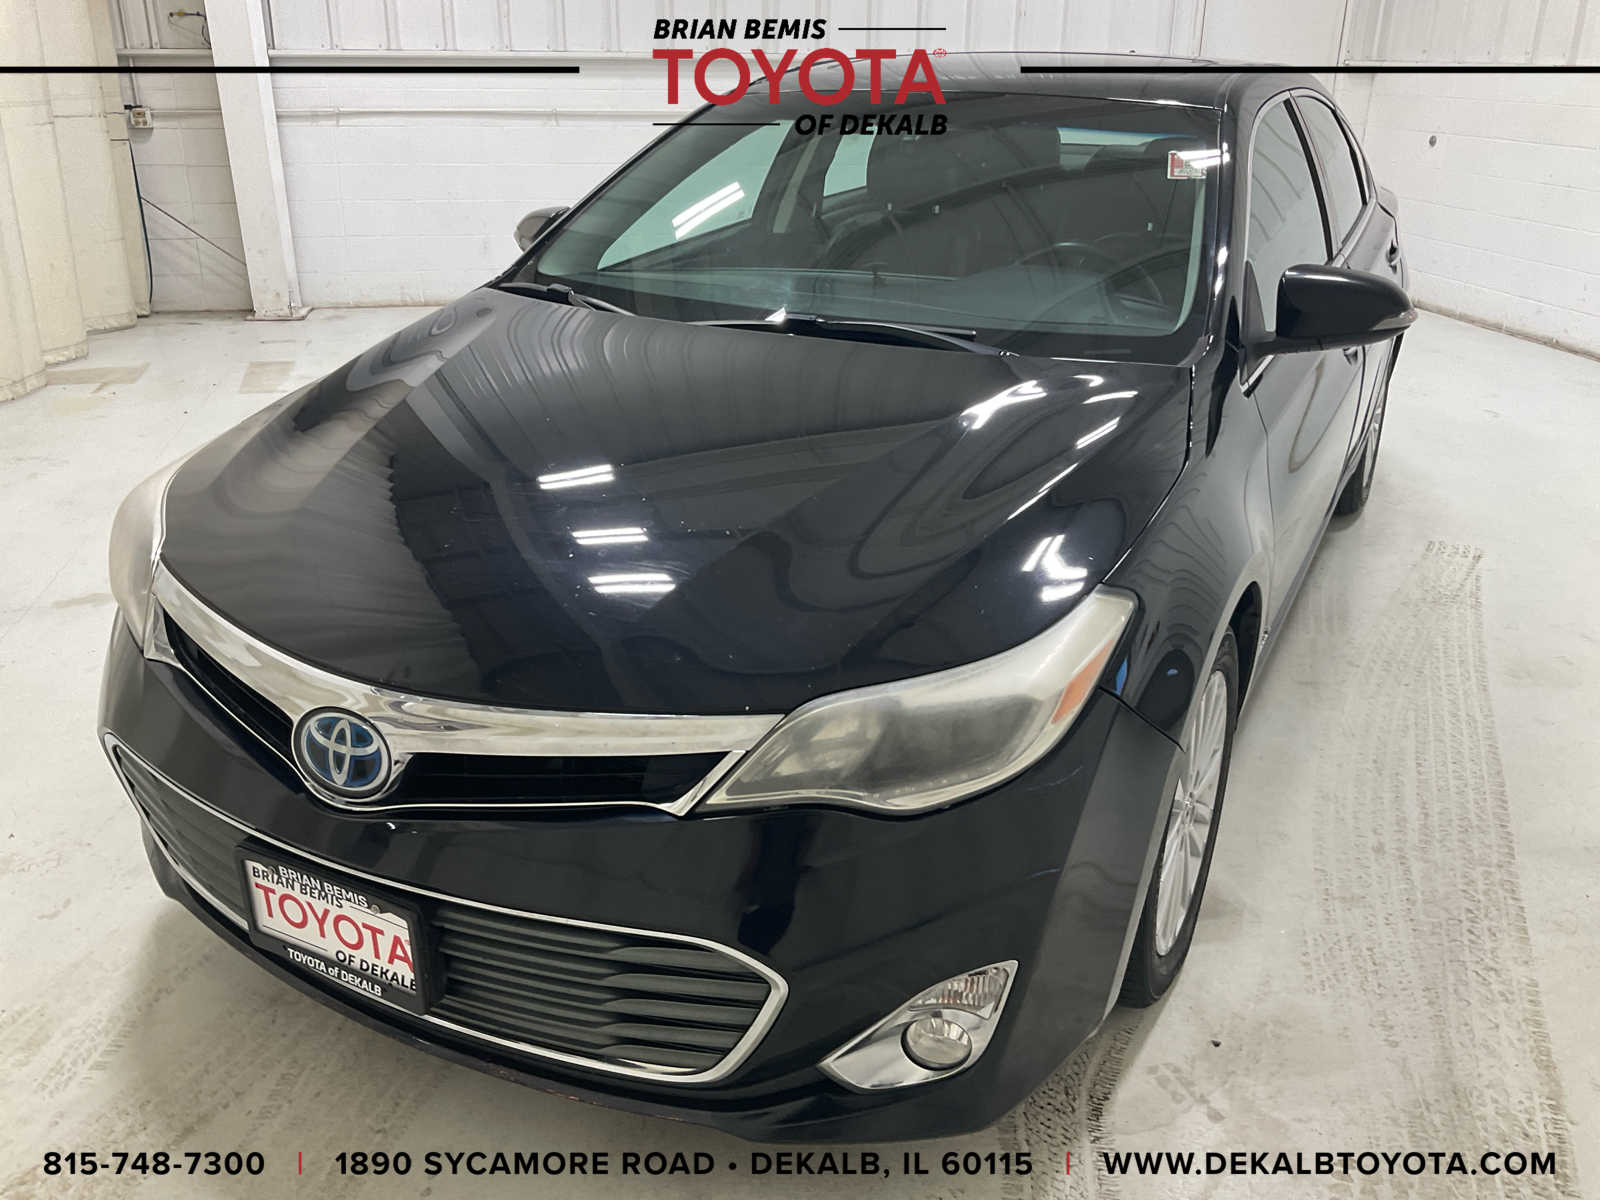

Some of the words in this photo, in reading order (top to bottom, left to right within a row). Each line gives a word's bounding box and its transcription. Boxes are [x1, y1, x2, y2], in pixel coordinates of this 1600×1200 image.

[278, 865, 321, 890] BRIAN
[323, 881, 369, 908] BEMIS
[254, 881, 415, 974] TOYOTA
[287, 947, 327, 974] TOYOTA
[328, 966, 339, 978] of
[341, 969, 382, 997] DEKALB
[335, 949, 356, 967] OF
